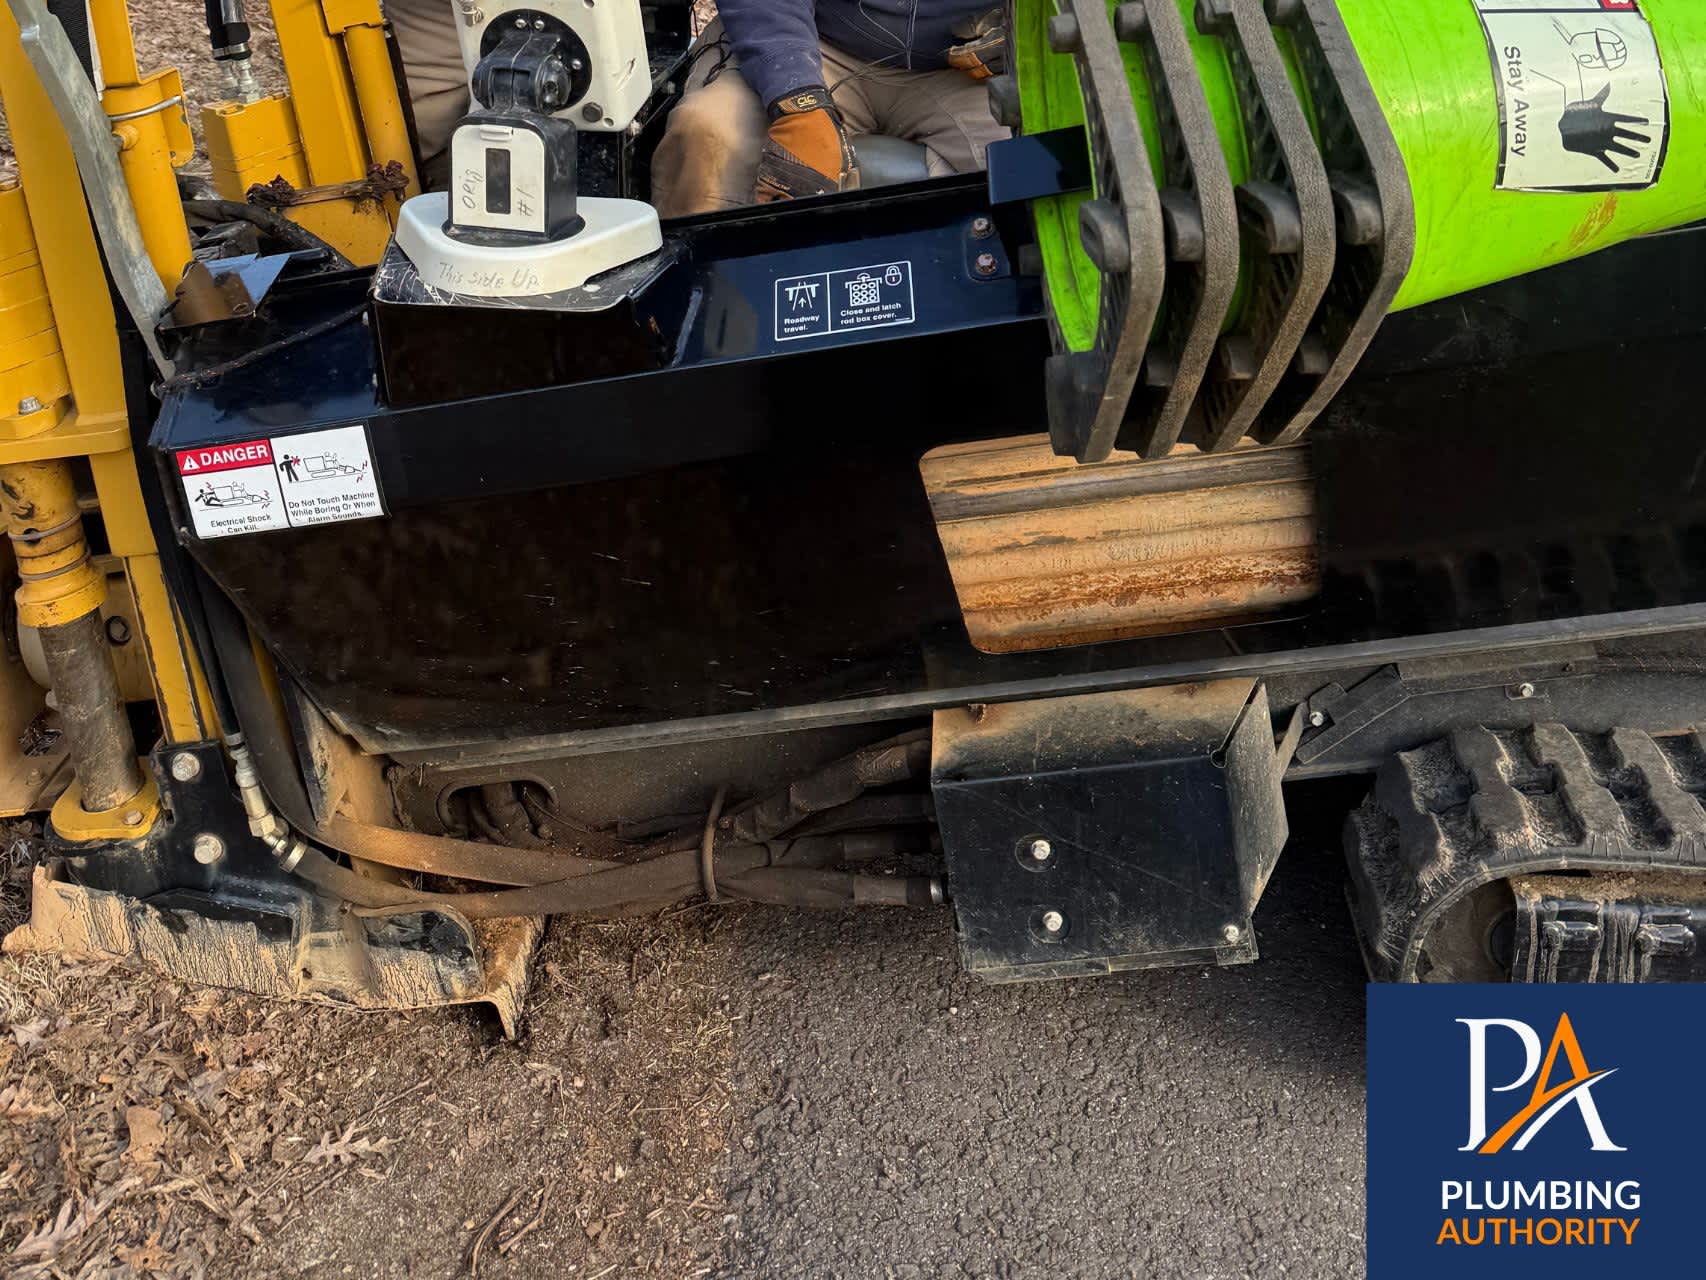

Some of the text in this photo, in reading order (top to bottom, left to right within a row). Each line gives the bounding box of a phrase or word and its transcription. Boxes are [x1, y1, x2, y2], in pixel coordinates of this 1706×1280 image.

[1503, 45, 1530, 157] Stay Away
[439, 261, 463, 284] This
[840, 302, 902, 317] Close and latch
[784, 314, 820, 325] Roadway
[840, 316, 854, 325] rod
[856, 315, 871, 323] box
[872, 313, 897, 321] cover.
[784, 324, 808, 334] travel.
[200, 444, 268, 466] DANGER
[288, 491, 375, 509] Do Not Touch Machine
[291, 500, 376, 517] While Boring Or When
[211, 514, 272, 528] Electrical Shock
[227, 525, 243, 534] Can
